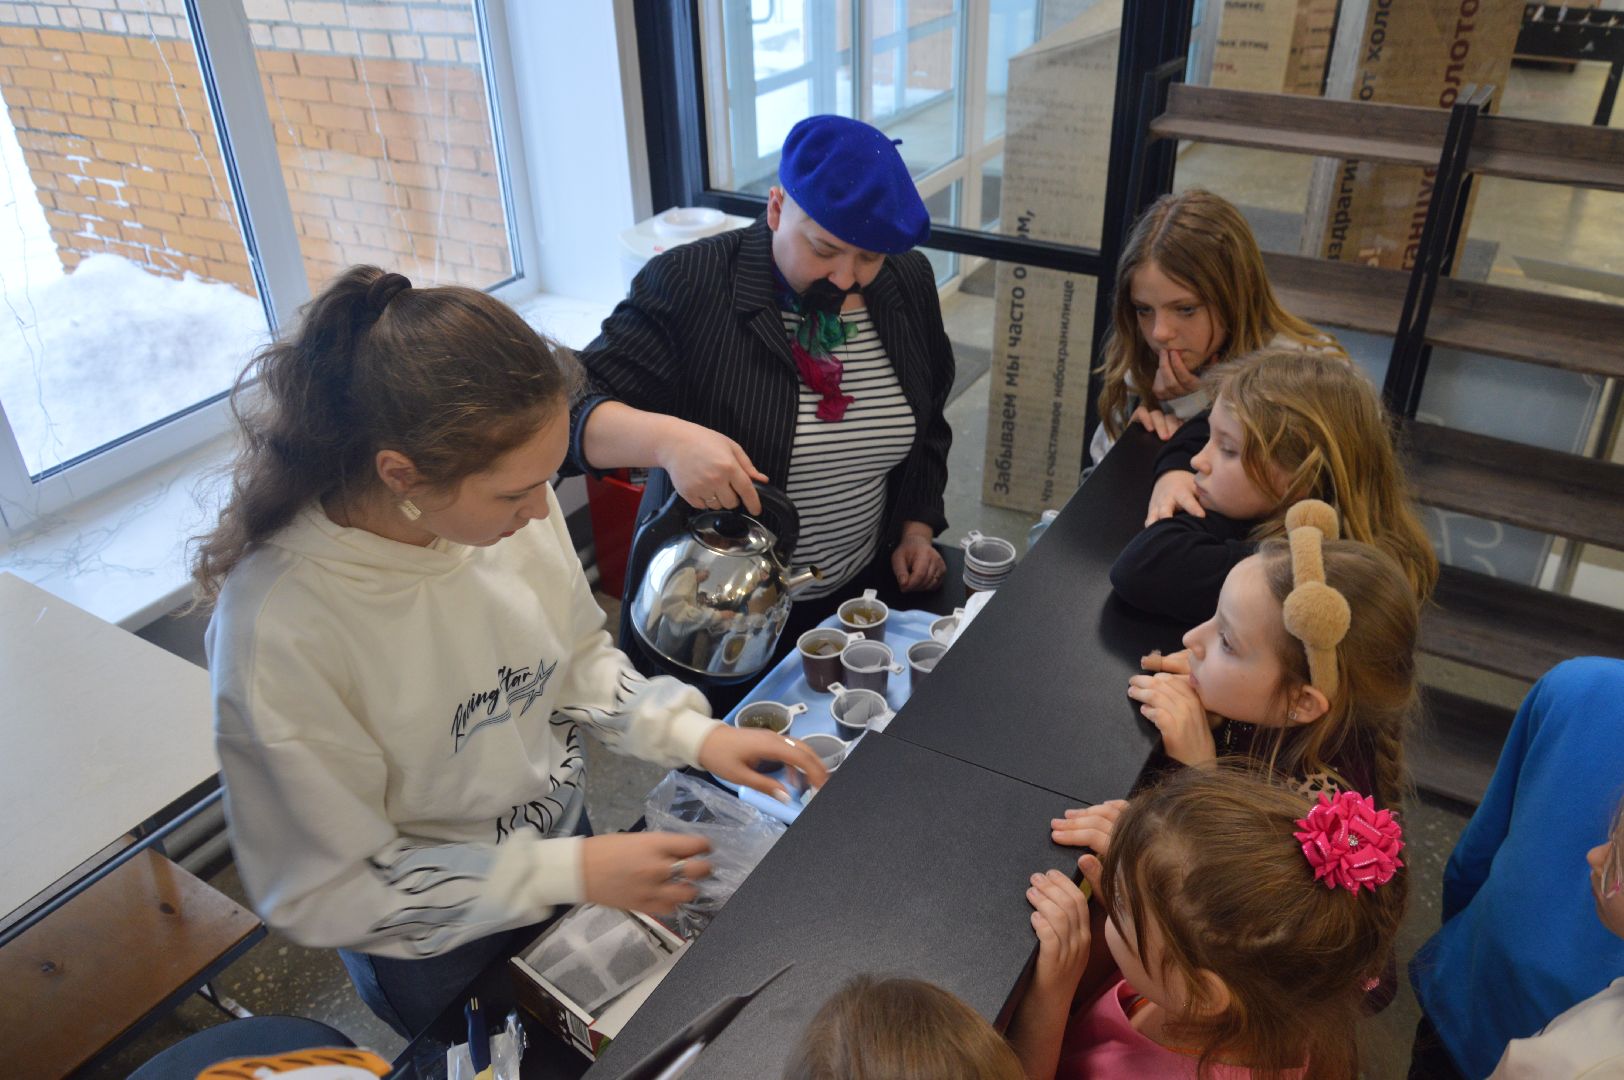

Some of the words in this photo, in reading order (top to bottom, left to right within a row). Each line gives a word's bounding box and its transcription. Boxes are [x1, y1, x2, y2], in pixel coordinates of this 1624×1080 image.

[1008, 286, 1025, 347] часто
[1005, 354, 1020, 387] мы
[993, 393, 1017, 495] Забываем
